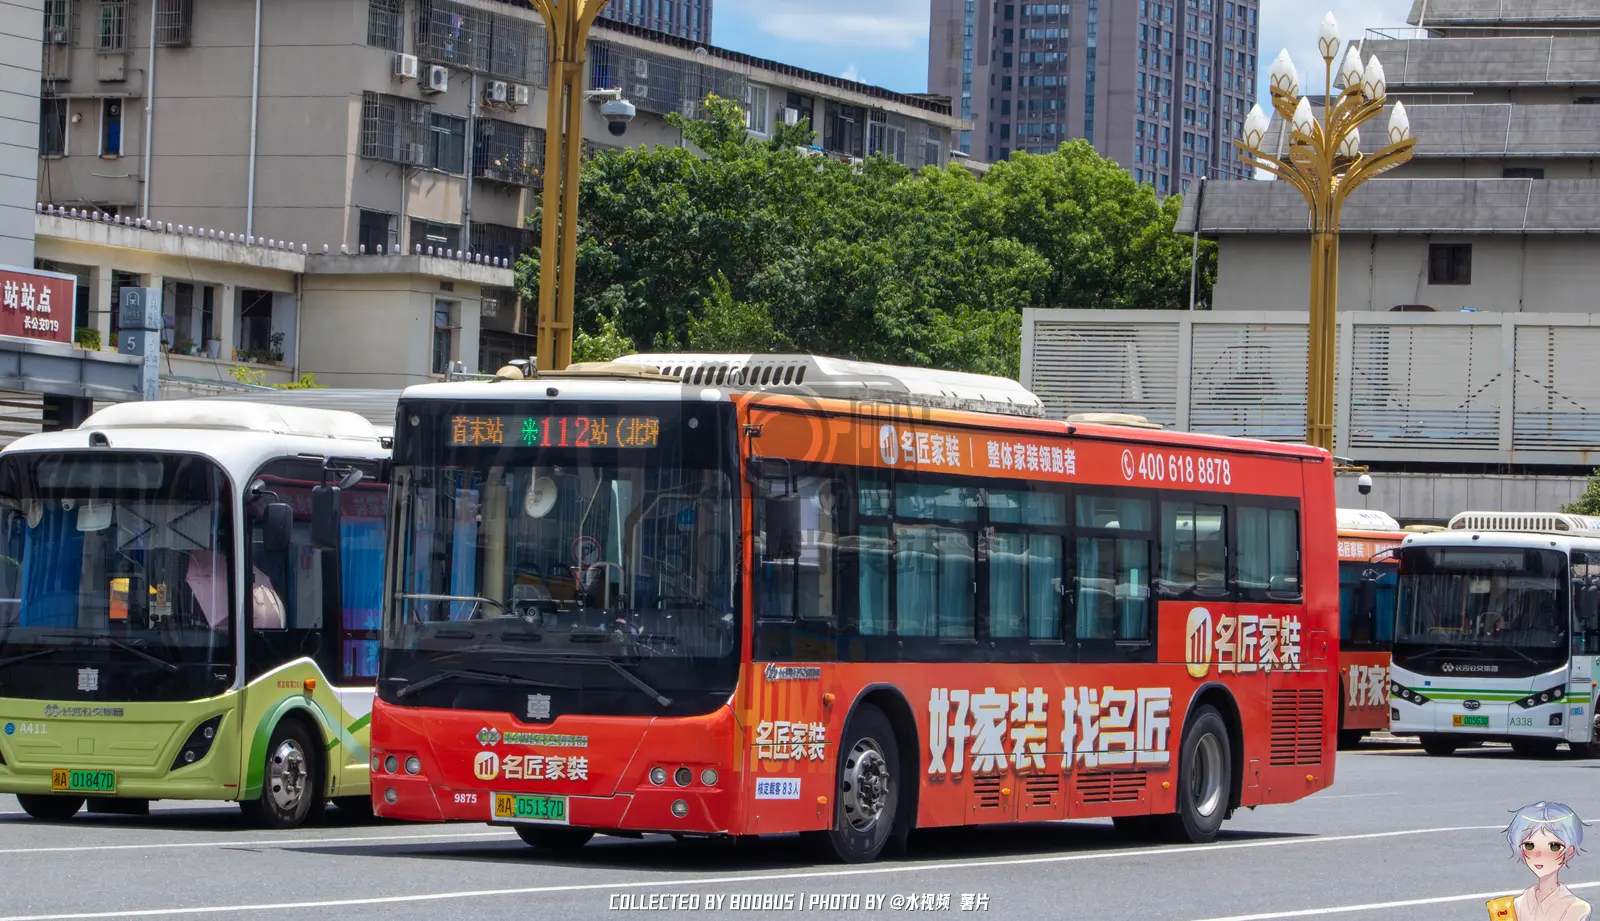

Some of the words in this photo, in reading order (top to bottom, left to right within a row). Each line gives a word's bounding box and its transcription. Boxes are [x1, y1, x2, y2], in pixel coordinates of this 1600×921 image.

[0, 280, 52, 313] 站站点
[127, 336, 136, 351] 5
[451, 416, 504, 445] 首末站
[540, 417, 590, 447] 112
[987, 440, 1076, 475] 整体家装领跑者
[1139, 452, 1164, 480] 400
[1169, 455, 1194, 483] 618
[1198, 456, 1231, 486] 8878
[20, 723, 47, 735] A411
[928, 687, 1049, 774] 好家装
[1061, 686, 1172, 769] 找名匠
[1510, 717, 1533, 727] A338
[72, 772, 113, 788] 01847D
[454, 793, 477, 804] 9875
[518, 799, 564, 817] 05137D
